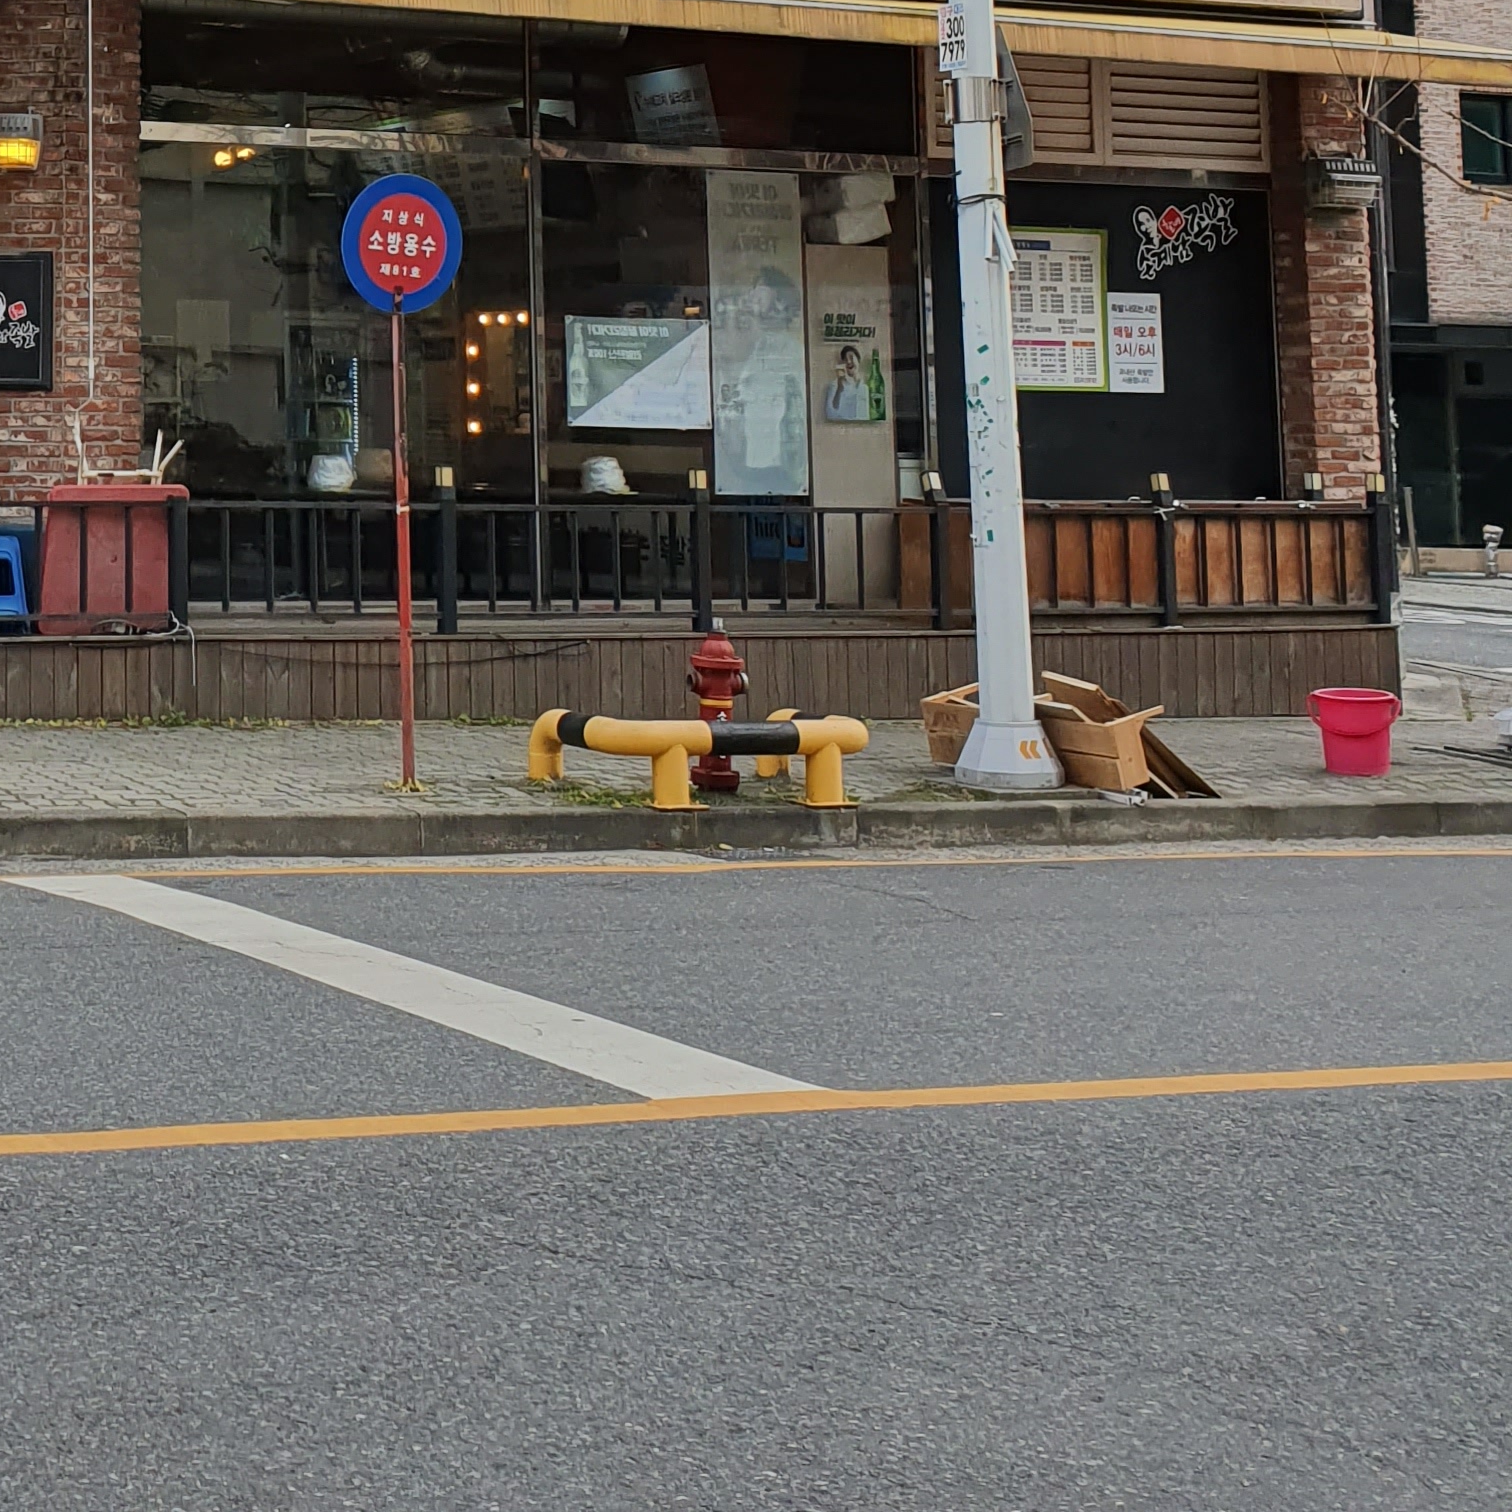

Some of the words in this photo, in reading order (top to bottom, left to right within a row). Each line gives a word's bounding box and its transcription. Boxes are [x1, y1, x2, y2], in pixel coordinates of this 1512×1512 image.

[946, 15, 965, 39] 300
[941, 39, 965, 63] 7979
[368, 230, 436, 258] 소방용수
[1114, 326, 1133, 338] 매일
[1137, 326, 1157, 339] 오후
[1115, 342, 1155, 357] 3시/6시
